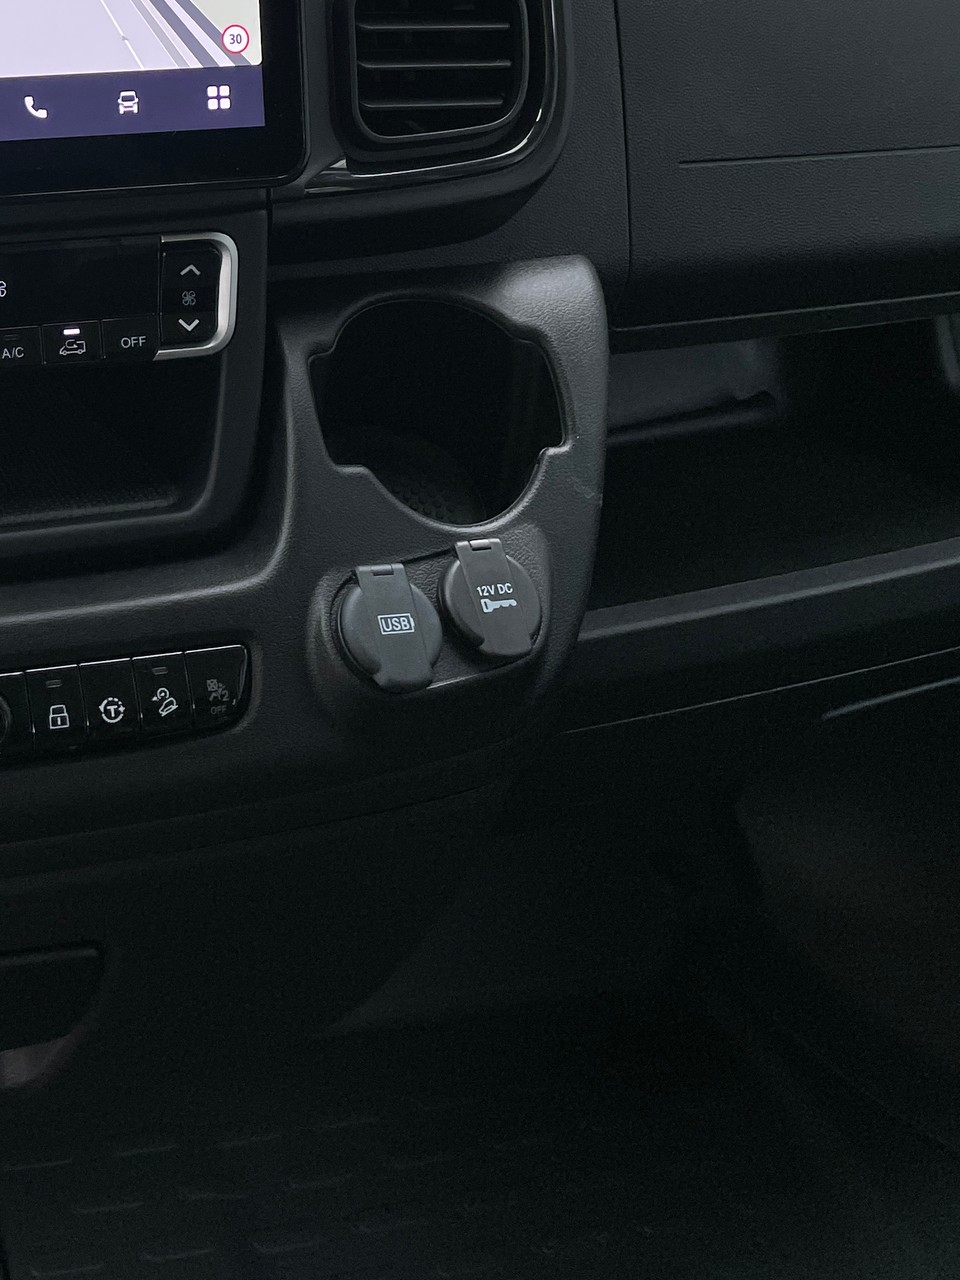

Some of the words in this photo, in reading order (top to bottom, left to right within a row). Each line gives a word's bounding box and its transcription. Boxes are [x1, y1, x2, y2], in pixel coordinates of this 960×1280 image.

[229, 34, 242, 45] 30
[120, 336, 147, 349] OFF
[1, 347, 25, 359] A/C
[476, 584, 496, 597] 12V
[497, 582, 514, 594] DC
[381, 617, 411, 632] USB
[106, 705, 118, 717] T
[210, 705, 228, 715] OFF
